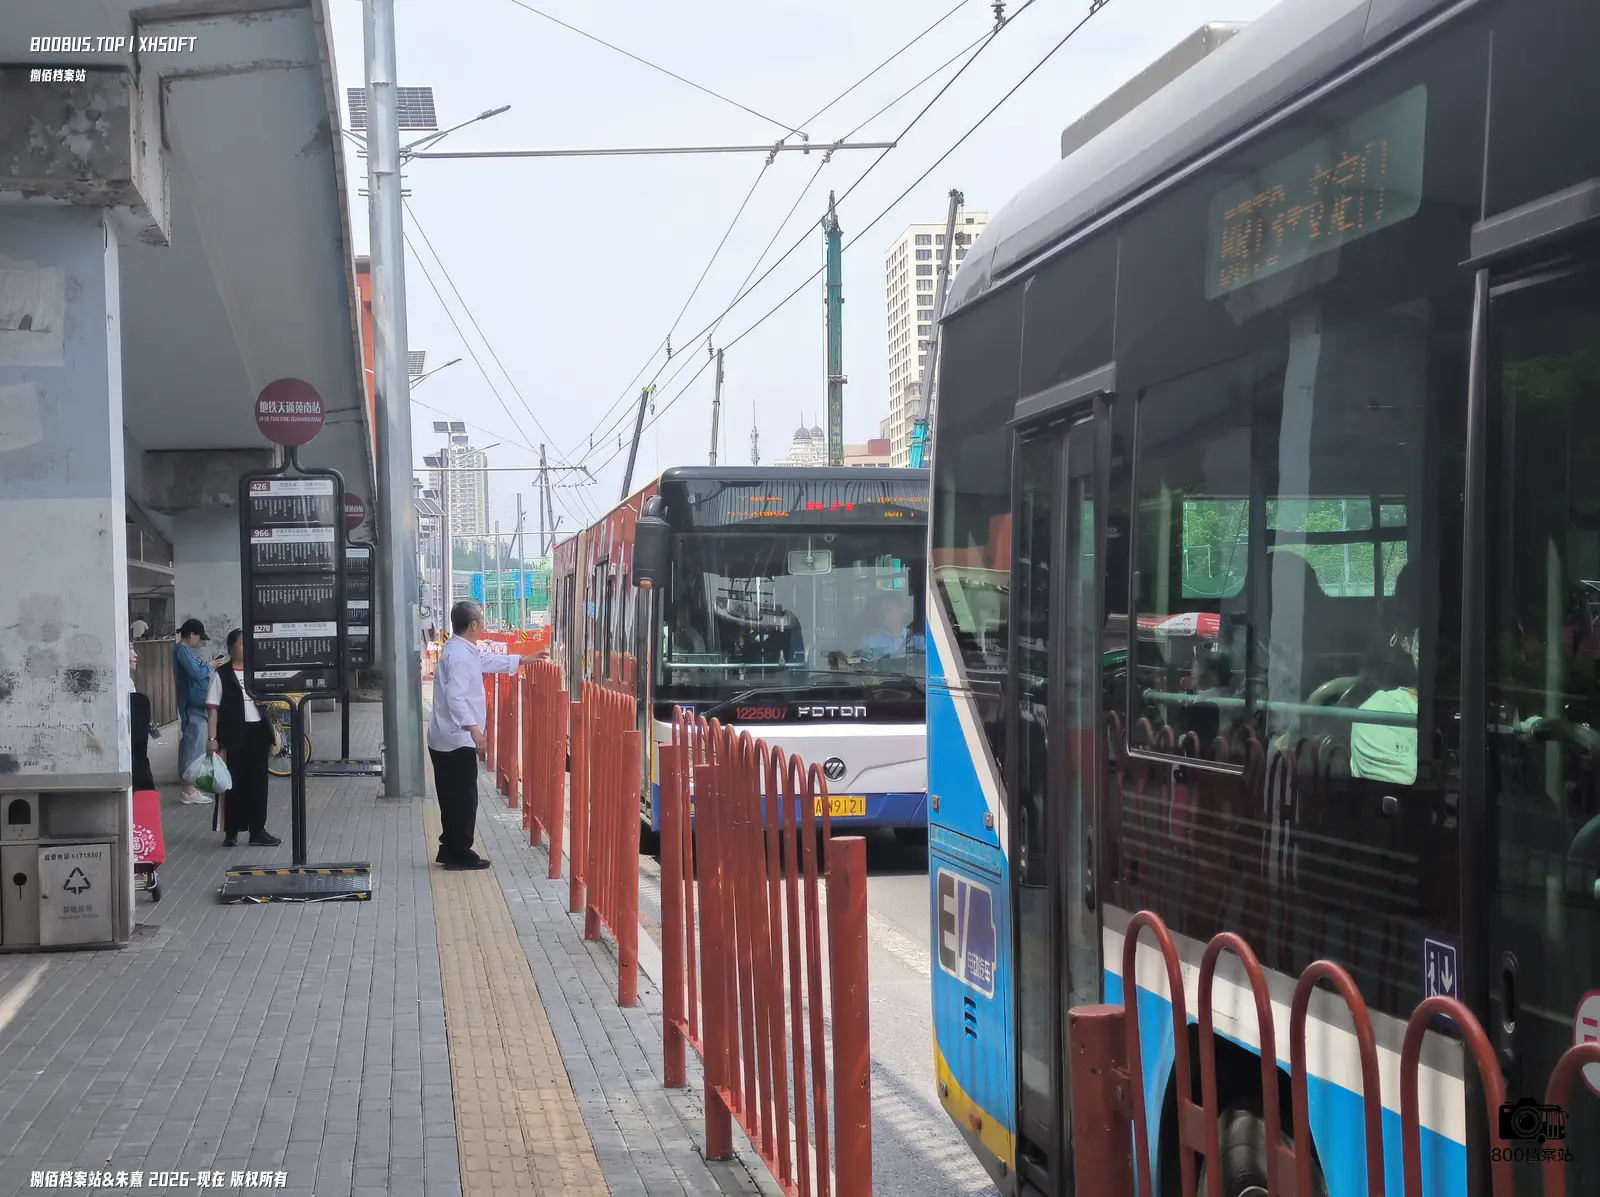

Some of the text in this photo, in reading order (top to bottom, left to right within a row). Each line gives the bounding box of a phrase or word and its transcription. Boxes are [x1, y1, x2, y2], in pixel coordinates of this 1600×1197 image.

[259, 400, 321, 415] 地铁天通苑南站
[251, 483, 267, 491] 426
[254, 529, 269, 537] 966
[735, 707, 788, 720] 1225807
[797, 705, 867, 718] FOTON
[815, 799, 863, 814] AN9121
